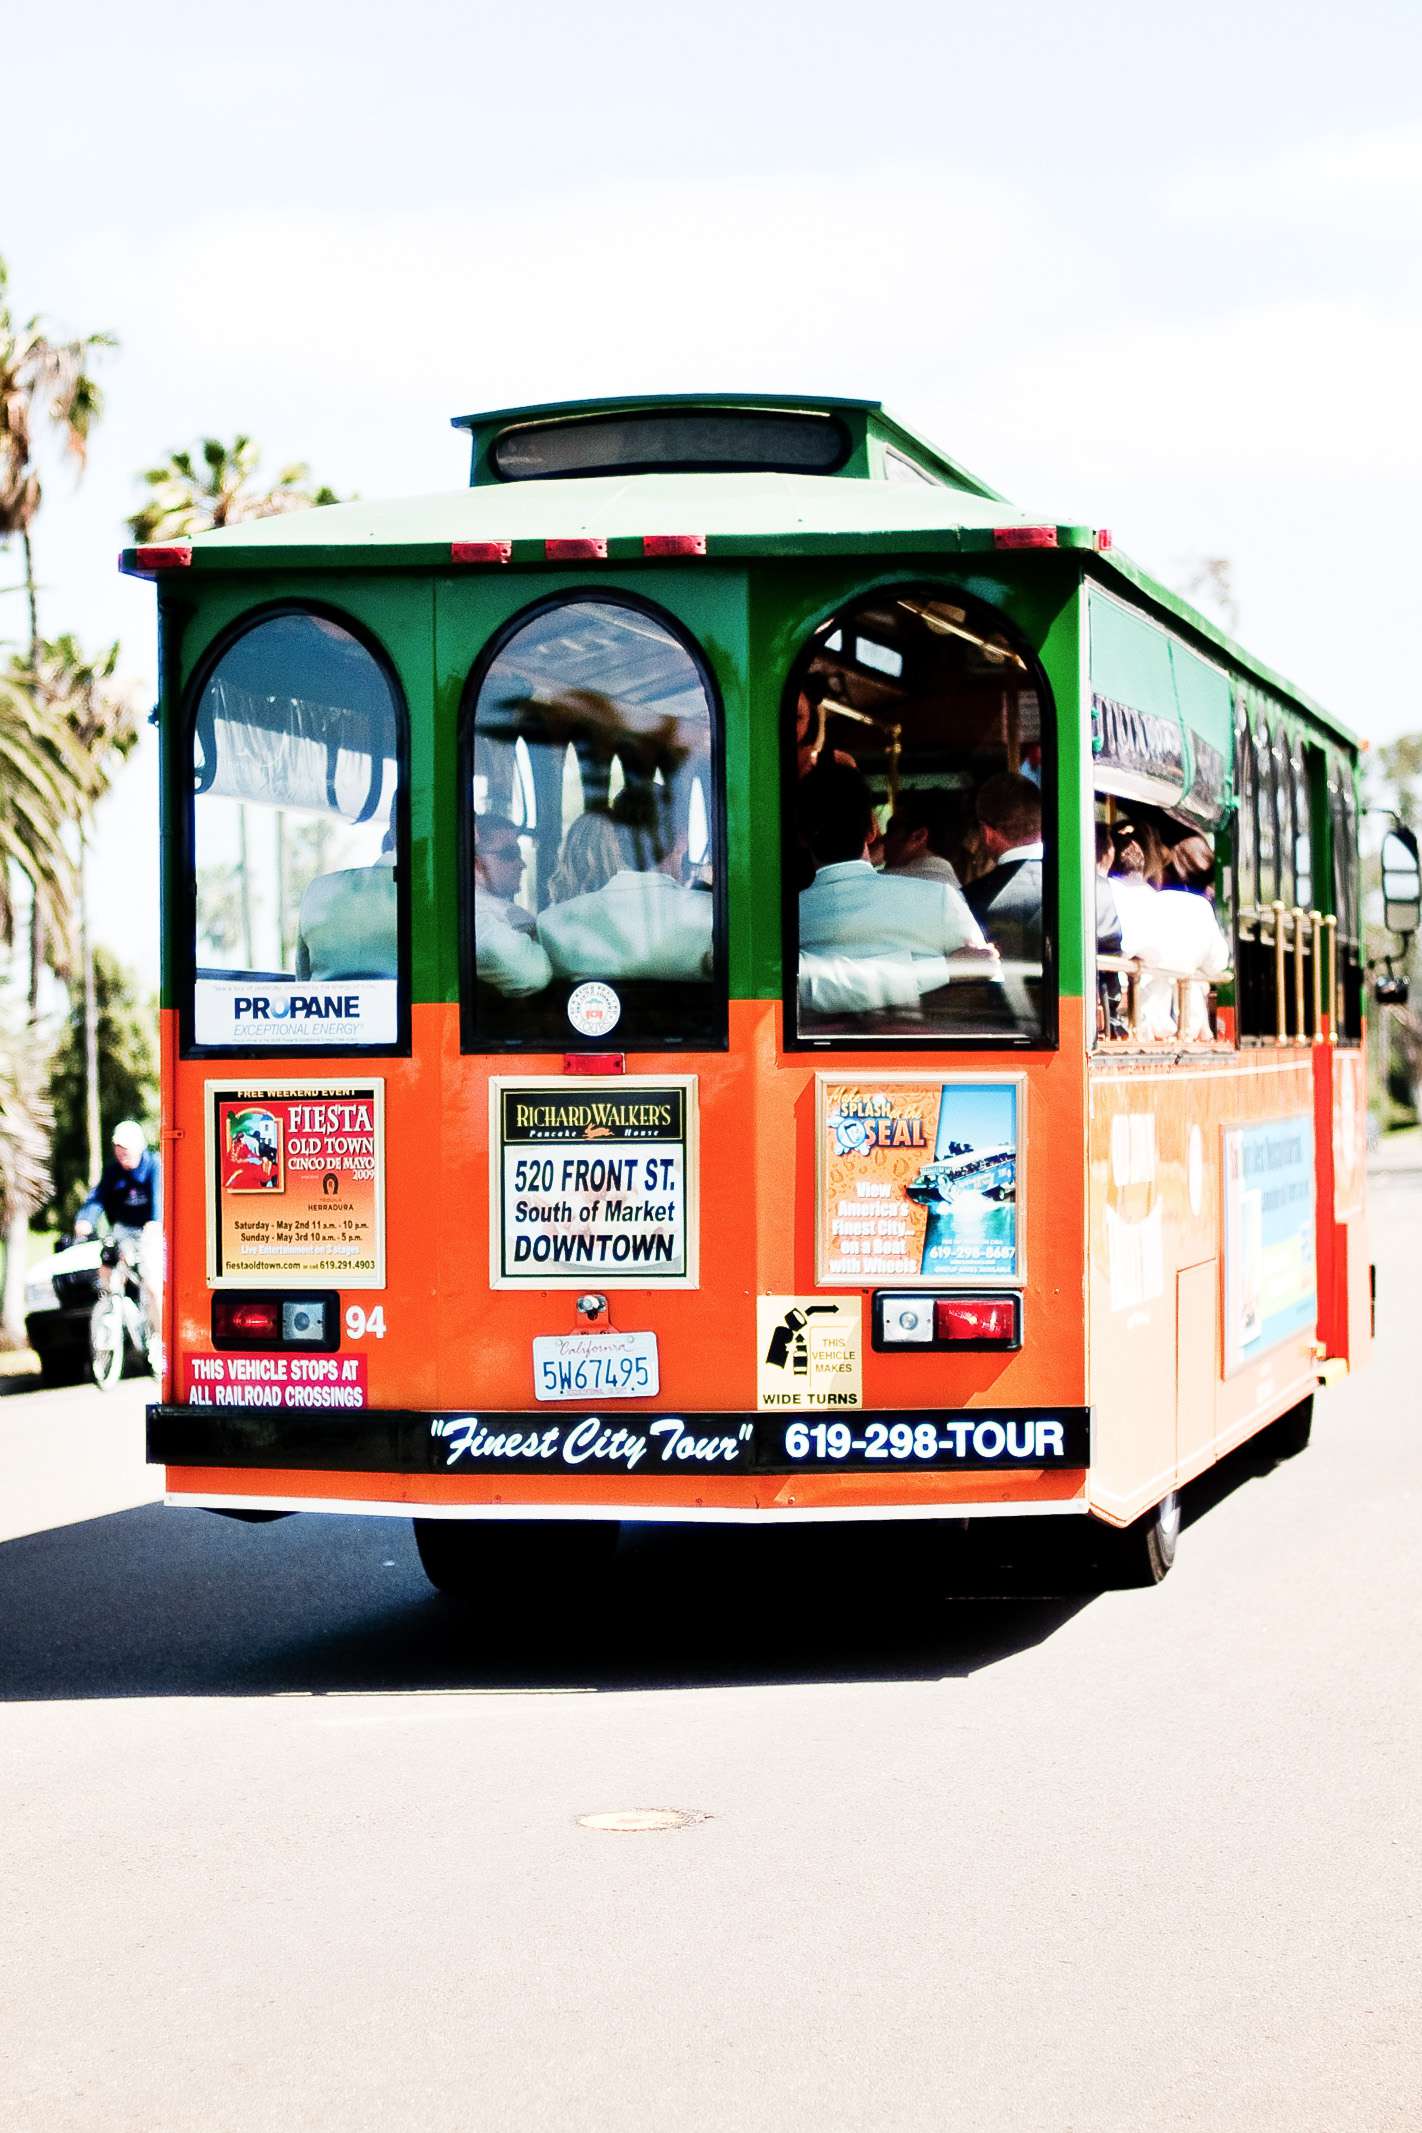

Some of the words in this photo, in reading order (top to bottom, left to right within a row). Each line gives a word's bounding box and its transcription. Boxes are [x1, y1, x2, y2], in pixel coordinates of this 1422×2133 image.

[234, 995, 360, 1019] PROPANE
[234, 1024, 309, 1036] EXCEPTIONAL
[238, 1090, 264, 1098] FREE
[267, 1090, 318, 1098] WEEKEND
[841, 1101, 891, 1118] SPLASH
[288, 1104, 374, 1136] FIESTA
[529, 1130, 577, 1138] Pancake
[624, 1129, 659, 1137] House
[863, 1118, 926, 1147] SEAL
[288, 1138, 322, 1155] OLD
[325, 1136, 374, 1154] TOWN
[288, 1157, 325, 1171] CINCO
[327, 1157, 341, 1171] DE
[343, 1156, 375, 1170] MAYO
[515, 1159, 554, 1192] 520
[562, 1159, 639, 1192] FRONT
[644, 1158, 675, 1191] ST.
[308, 1203, 354, 1211] HERRADURA
[515, 1200, 572, 1222] South
[579, 1200, 600, 1222] of
[605, 1200, 675, 1222] Market
[234, 1221, 269, 1230] Saturday
[276, 1221, 293, 1231] May
[295, 1221, 309, 1229] 2nd
[312, 1221, 321, 1229] 11
[344, 1221, 353, 1229] 10
[240, 1233, 269, 1243] Sunday
[276, 1233, 293, 1243] May
[295, 1233, 308, 1241] 3rd
[311, 1233, 321, 1241] 10
[341, 1233, 347, 1241] 5
[514, 1234, 675, 1262] DOWNTOWN
[226, 1261, 300, 1270] fiestaoldtown.com
[320, 1260, 375, 1270] 619.291.4903
[345, 1305, 387, 1340] 94
[822, 1338, 846, 1347] THIS
[812, 1350, 856, 1361] VEHICLE
[192, 1359, 224, 1380] THIS
[227, 1359, 287, 1380] VEHICLE
[290, 1360, 338, 1381] STOPS
[342, 1360, 358, 1381] AT
[543, 1356, 648, 1390] 5W67495
[815, 1363, 853, 1374] MAKES
[189, 1386, 212, 1406] ALL
[215, 1386, 282, 1407] RAILROAD
[285, 1387, 363, 1407] CROSSINGS
[763, 1393, 801, 1405] WIDE
[807, 1392, 858, 1405] TURNS
[431, 1417, 559, 1466] "Finest
[563, 1417, 647, 1469] City
[650, 1419, 753, 1461] Tour"
[785, 1421, 1064, 1459] 619-298-TOUR
